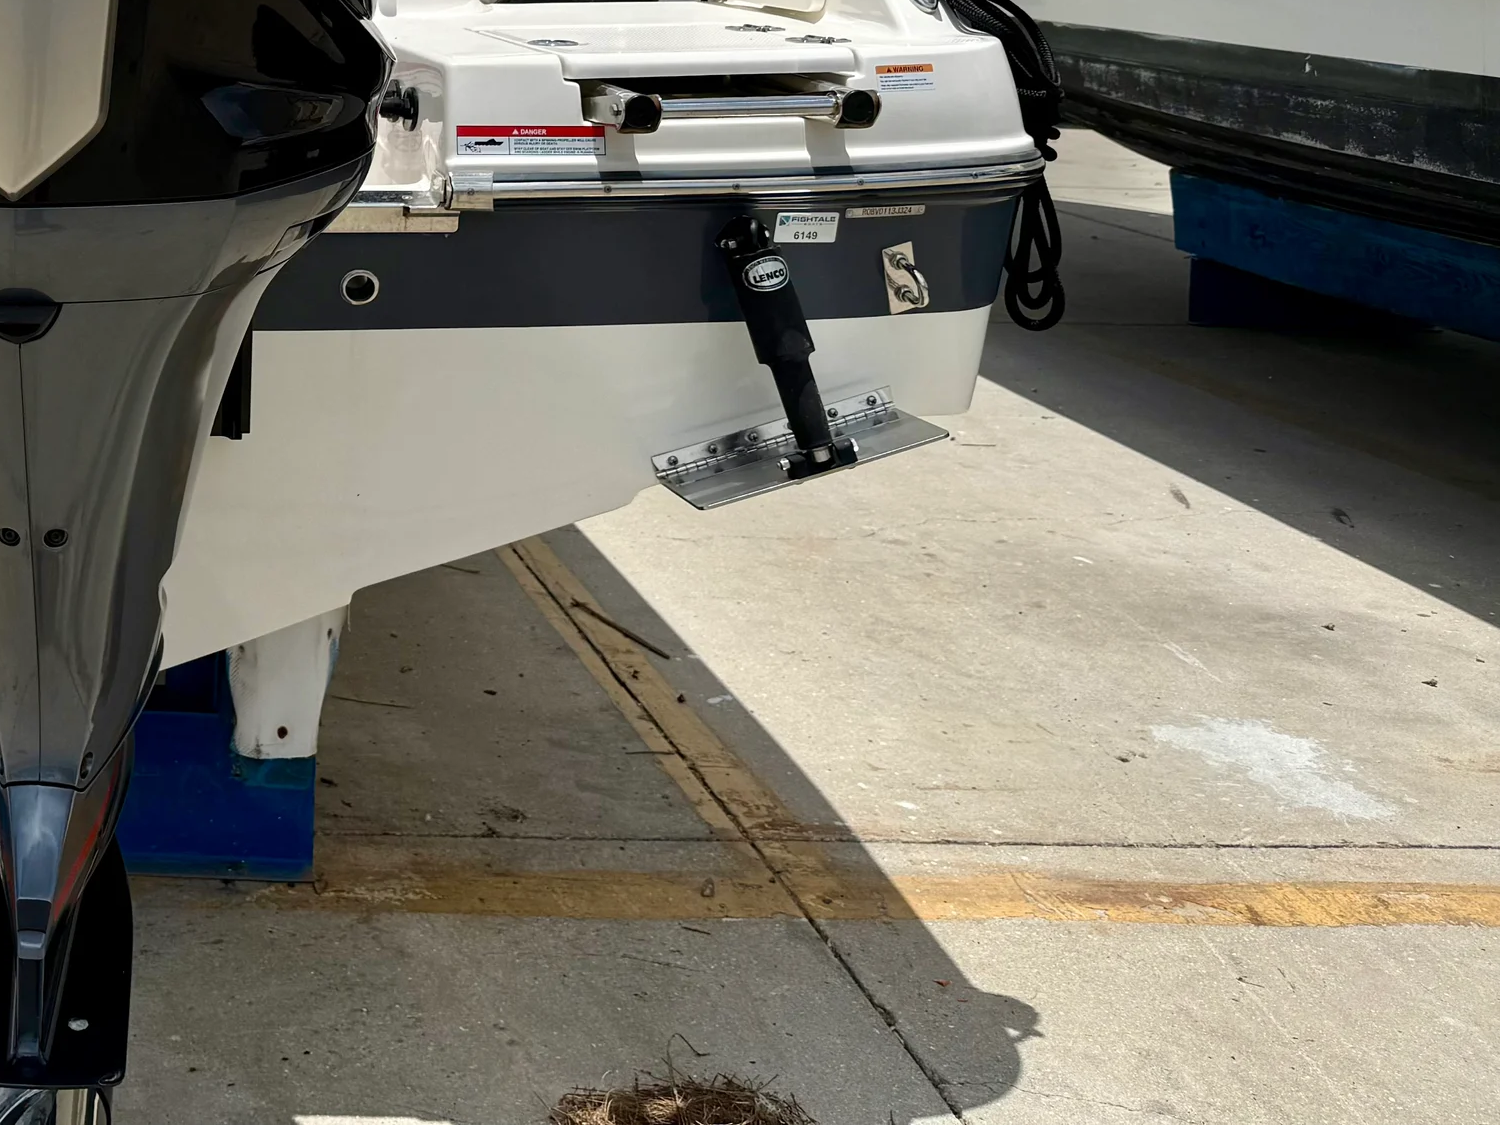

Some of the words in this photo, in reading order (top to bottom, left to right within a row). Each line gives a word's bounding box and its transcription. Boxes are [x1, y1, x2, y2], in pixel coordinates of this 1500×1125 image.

[893, 65, 924, 73] WARNING
[520, 128, 547, 136] DANGER
[793, 231, 818, 240] 6149
[752, 268, 785, 284] LENCO
